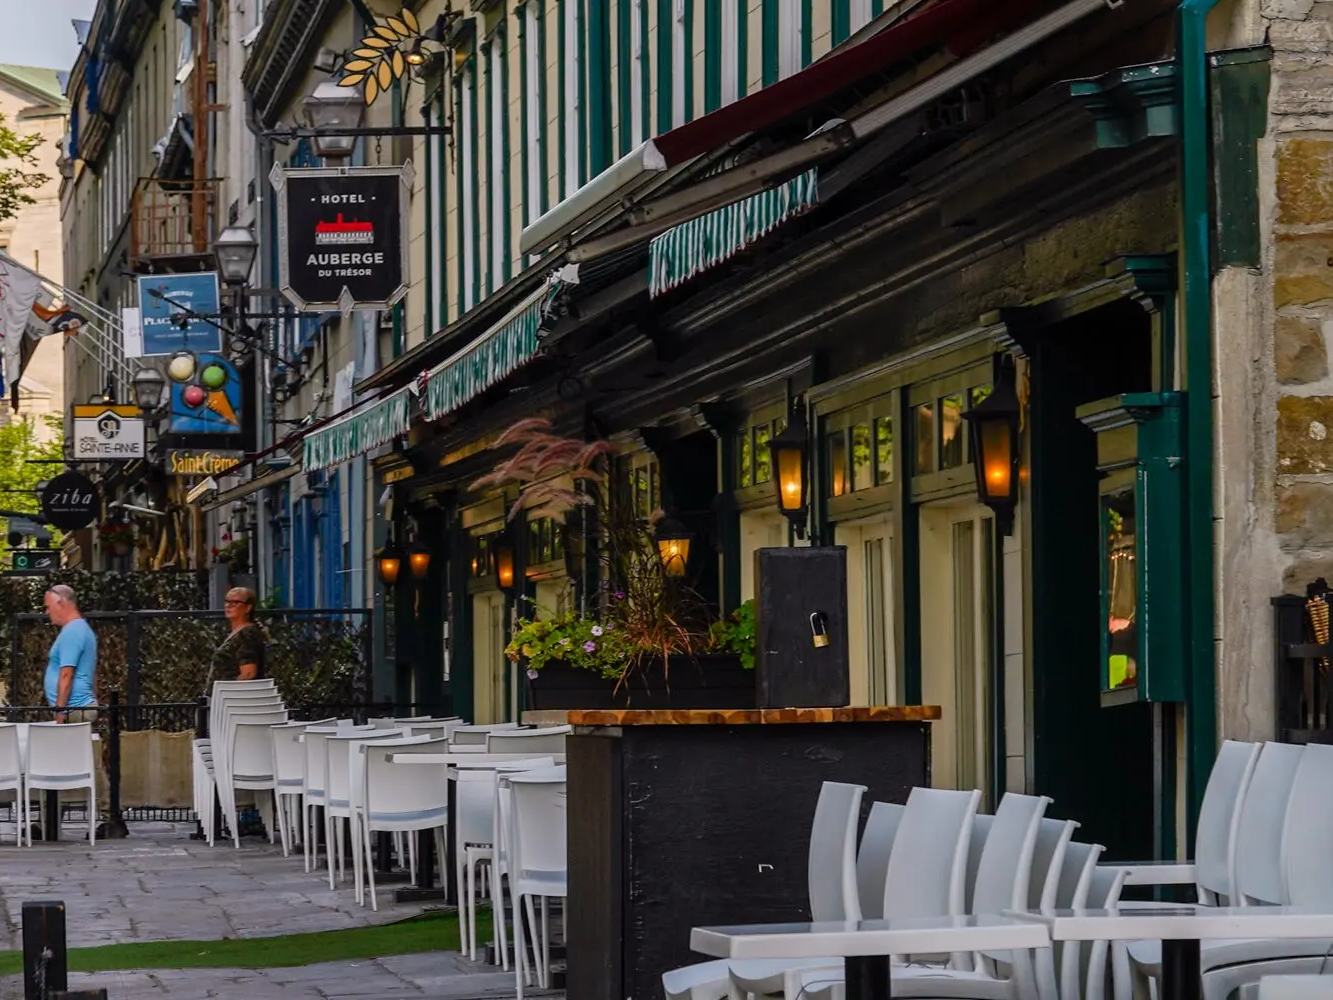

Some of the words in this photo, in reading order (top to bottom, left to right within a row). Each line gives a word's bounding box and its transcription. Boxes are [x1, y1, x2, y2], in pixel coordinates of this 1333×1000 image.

[321, 194, 365, 204] HOTEL
[307, 252, 384, 265] AUBERGE
[318, 269, 332, 277] DU
[334, 267, 372, 276] TRÉSOR
[79, 442, 140, 453] SAINTE-ANNE
[49, 488, 92, 504] ziba
